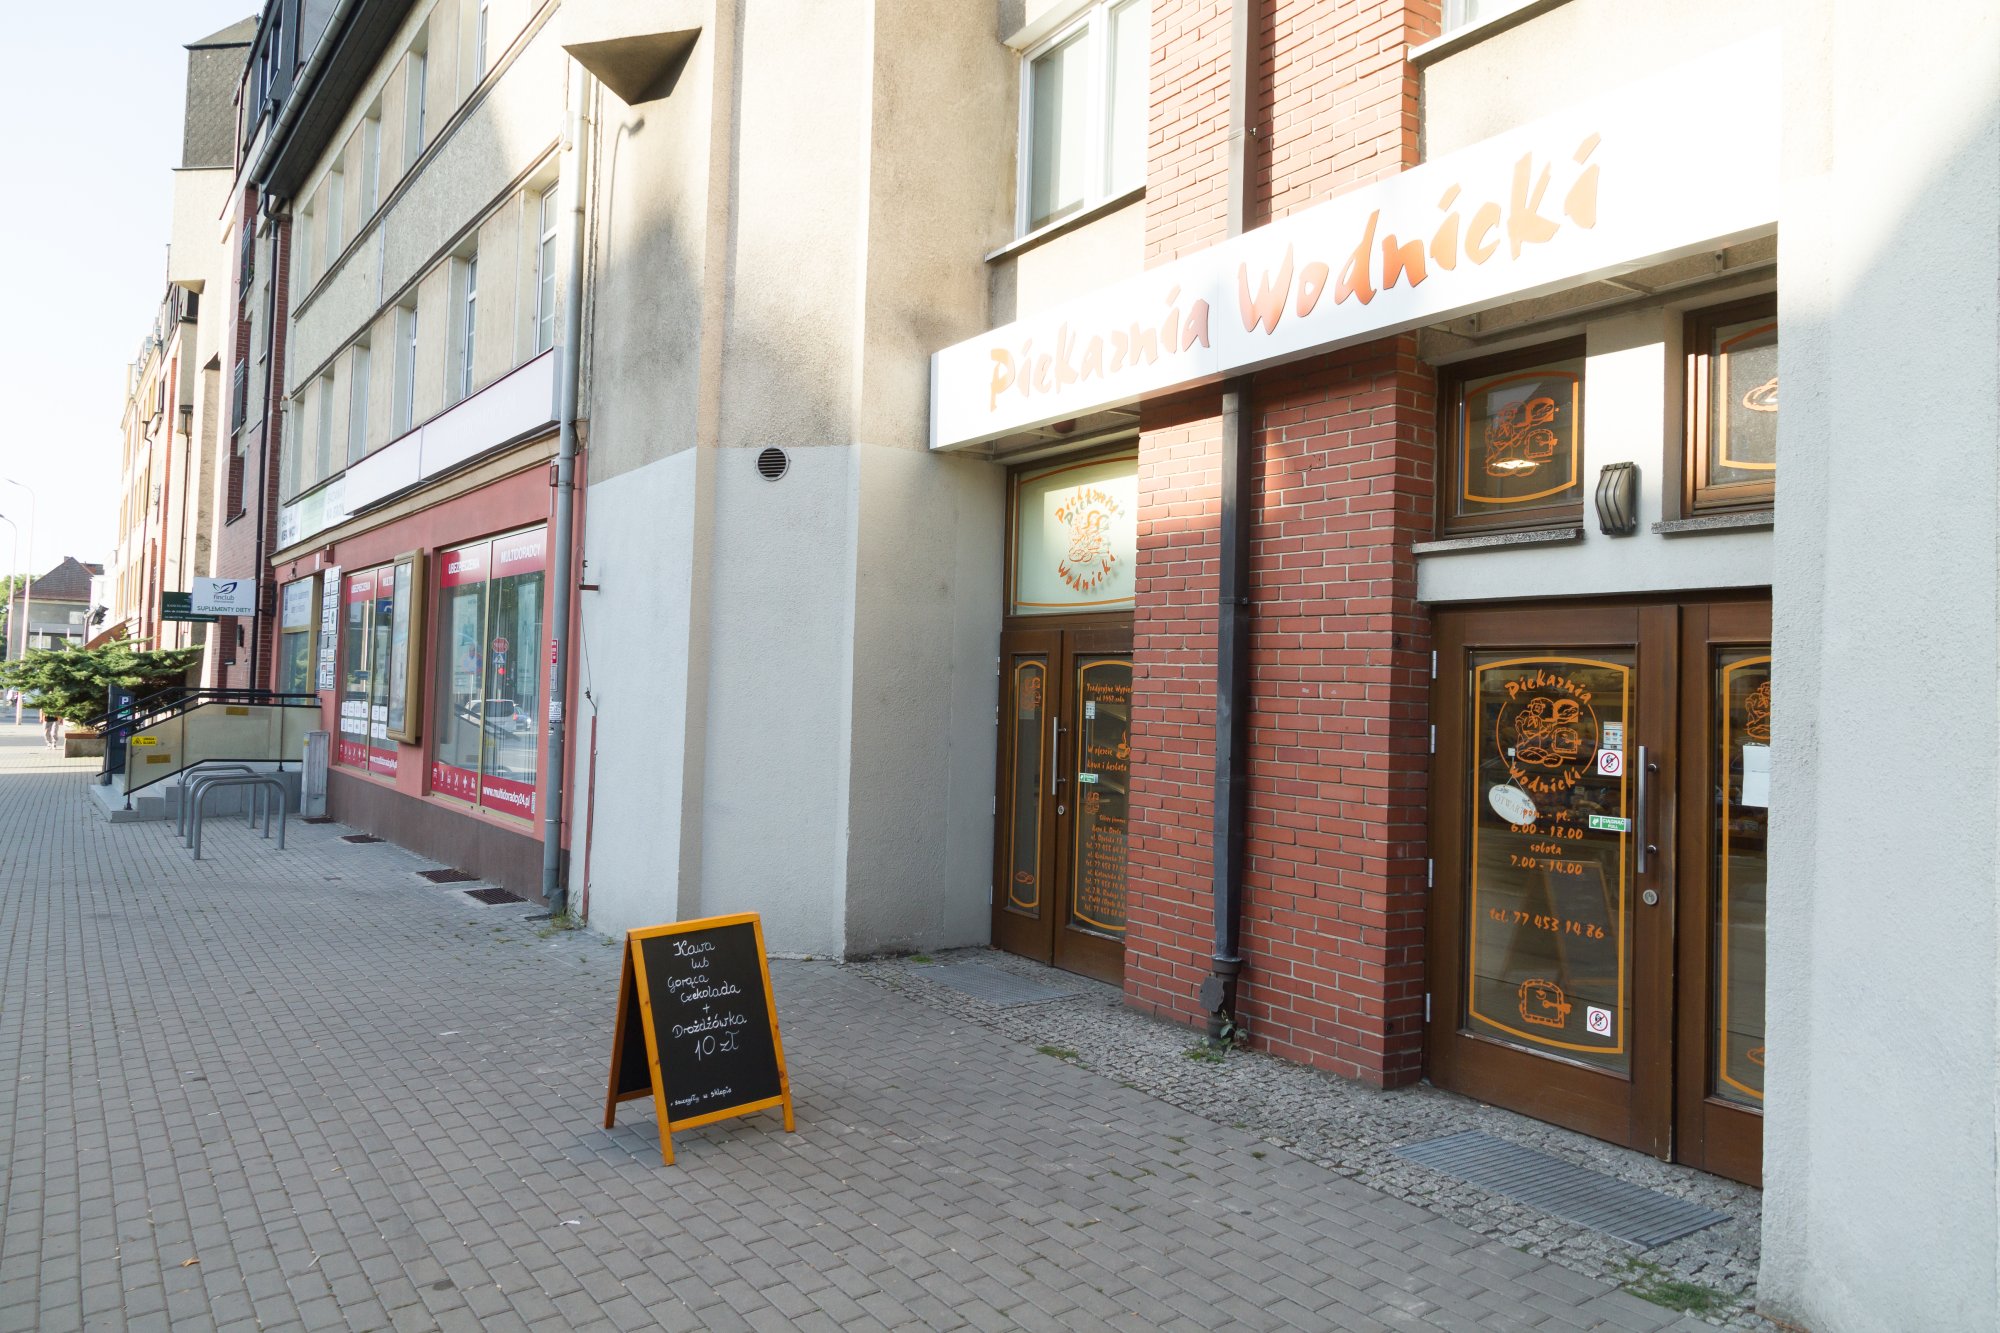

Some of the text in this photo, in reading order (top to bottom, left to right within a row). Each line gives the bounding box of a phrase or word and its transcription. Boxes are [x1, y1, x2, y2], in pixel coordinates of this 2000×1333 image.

[989, 132, 1602, 411] Piekarnia Wodnicki
[1058, 554, 1116, 592] Wodnicki
[197, 605, 234, 613] SUPLEMENTY
[1504, 668, 1592, 704] Piekarnia
[1509, 761, 1581, 793] Wodnicki
[1510, 823, 1537, 833] 6.00
[1550, 825, 1583, 840] 18.00
[1530, 842, 1561, 855] sobota
[1510, 854, 1536, 868] 7.00
[1549, 860, 1583, 875] 14.00
[1513, 911, 1530, 926] 77
[1534, 914, 1559, 931] 453
[1565, 920, 1581, 936] 14
[673, 939, 716, 957] Kawa
[691, 956, 710, 969] lub
[672, 1012, 748, 1039] Drożdżówka
[694, 1030, 740, 1061] 10 zł
